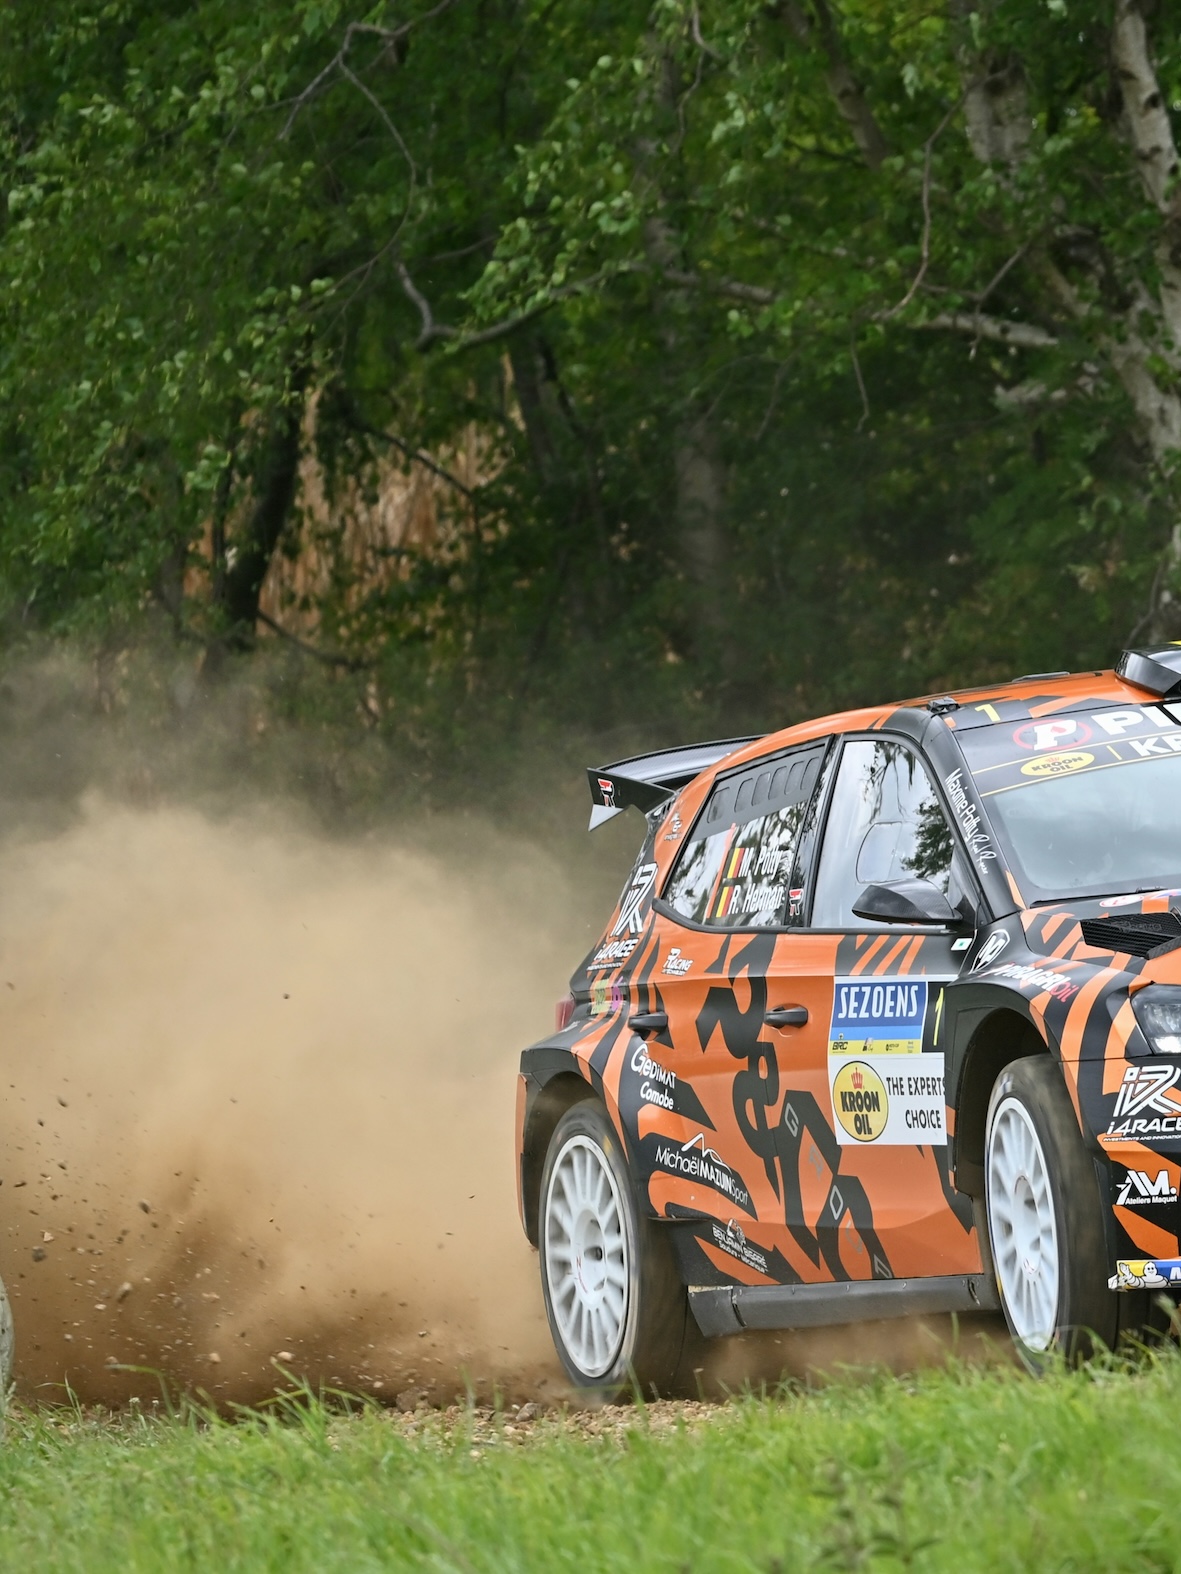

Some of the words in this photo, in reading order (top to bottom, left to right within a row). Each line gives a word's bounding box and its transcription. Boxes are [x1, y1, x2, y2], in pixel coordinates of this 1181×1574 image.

[974, 703, 1001, 723] 1
[1031, 756, 1084, 772] KROON
[1049, 763, 1074, 774] OIL
[728, 884, 742, 915] R.
[742, 882, 784, 914] Herman
[838, 984, 919, 1019] SEZOENS
[933, 987, 945, 1047] 1
[832, 1041, 849, 1051] BRC
[639, 1081, 674, 1110] Comobe
[886, 1077, 905, 1096] THE
[840, 1090, 881, 1113] KROON
[853, 1113, 873, 1136] OIL
[905, 1109, 942, 1129] CHOICE
